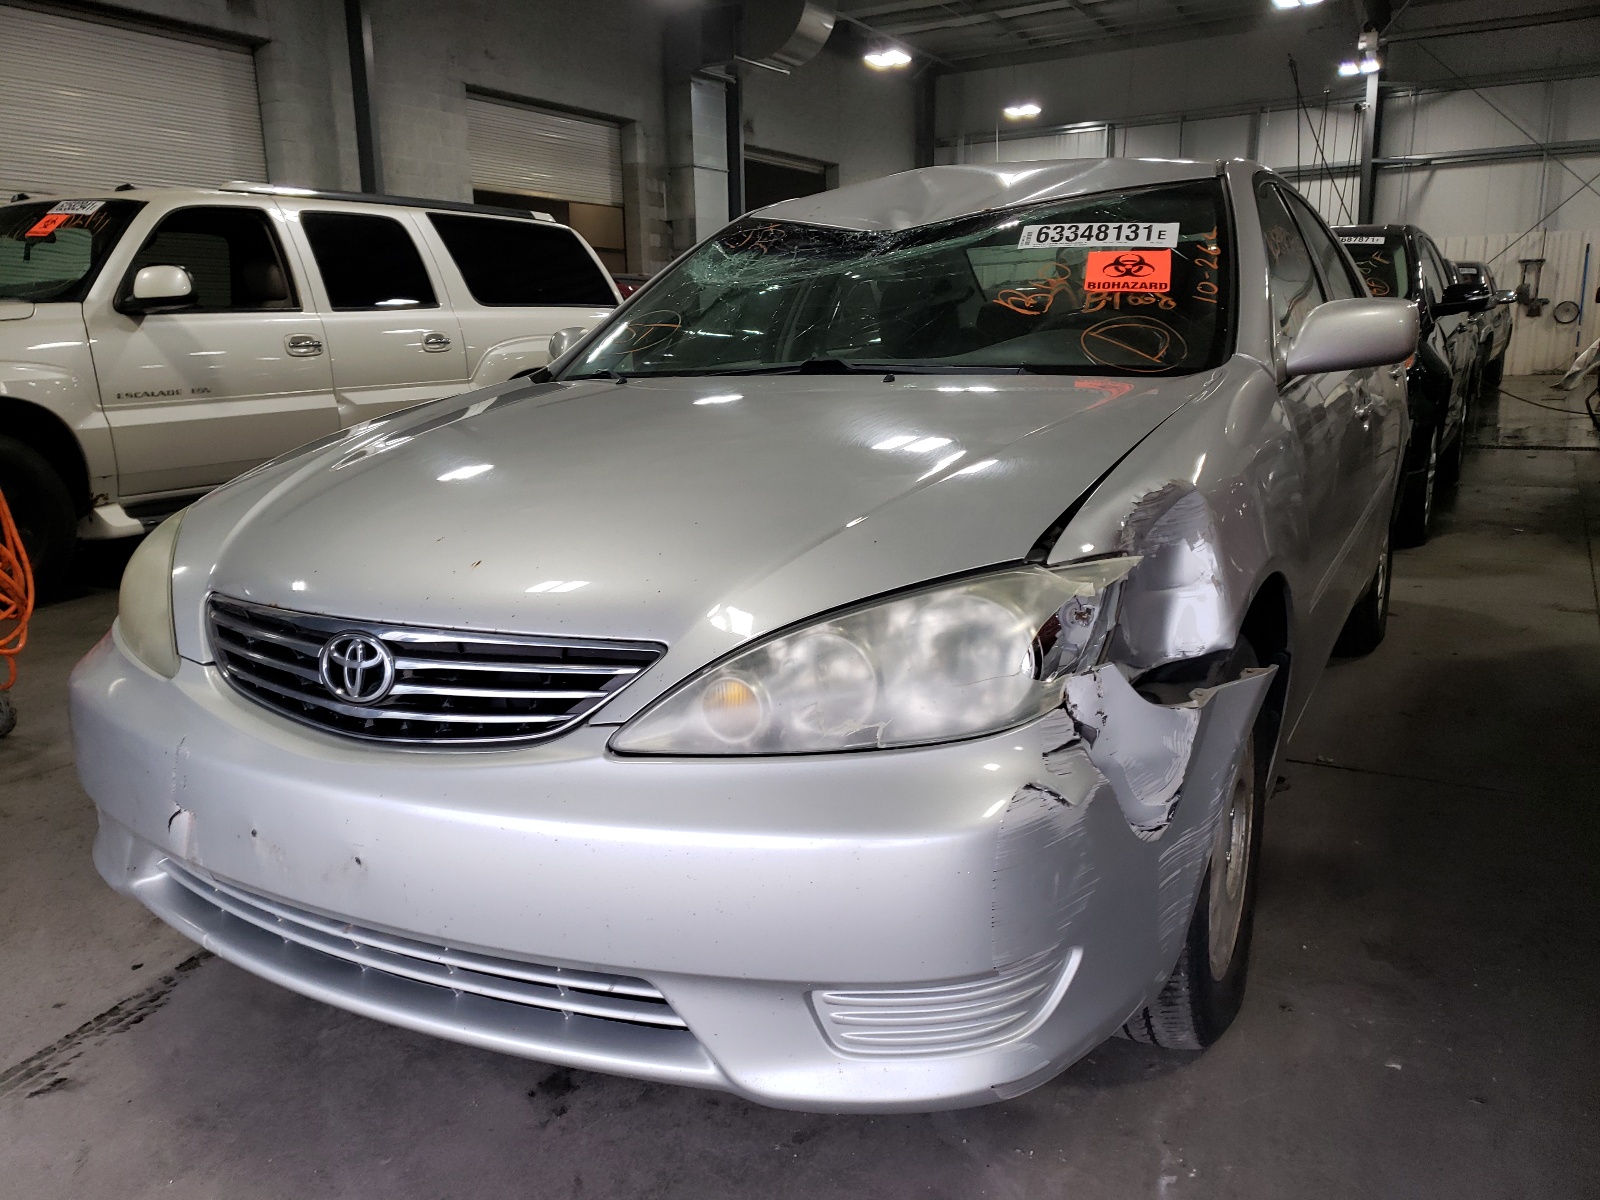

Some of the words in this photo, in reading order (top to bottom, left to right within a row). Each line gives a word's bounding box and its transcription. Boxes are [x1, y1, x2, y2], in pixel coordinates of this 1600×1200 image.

[1036, 223, 1153, 243] 63348131
[1087, 281, 1168, 290] BIOHAZARD
[116, 389, 182, 400] ESCALADE
